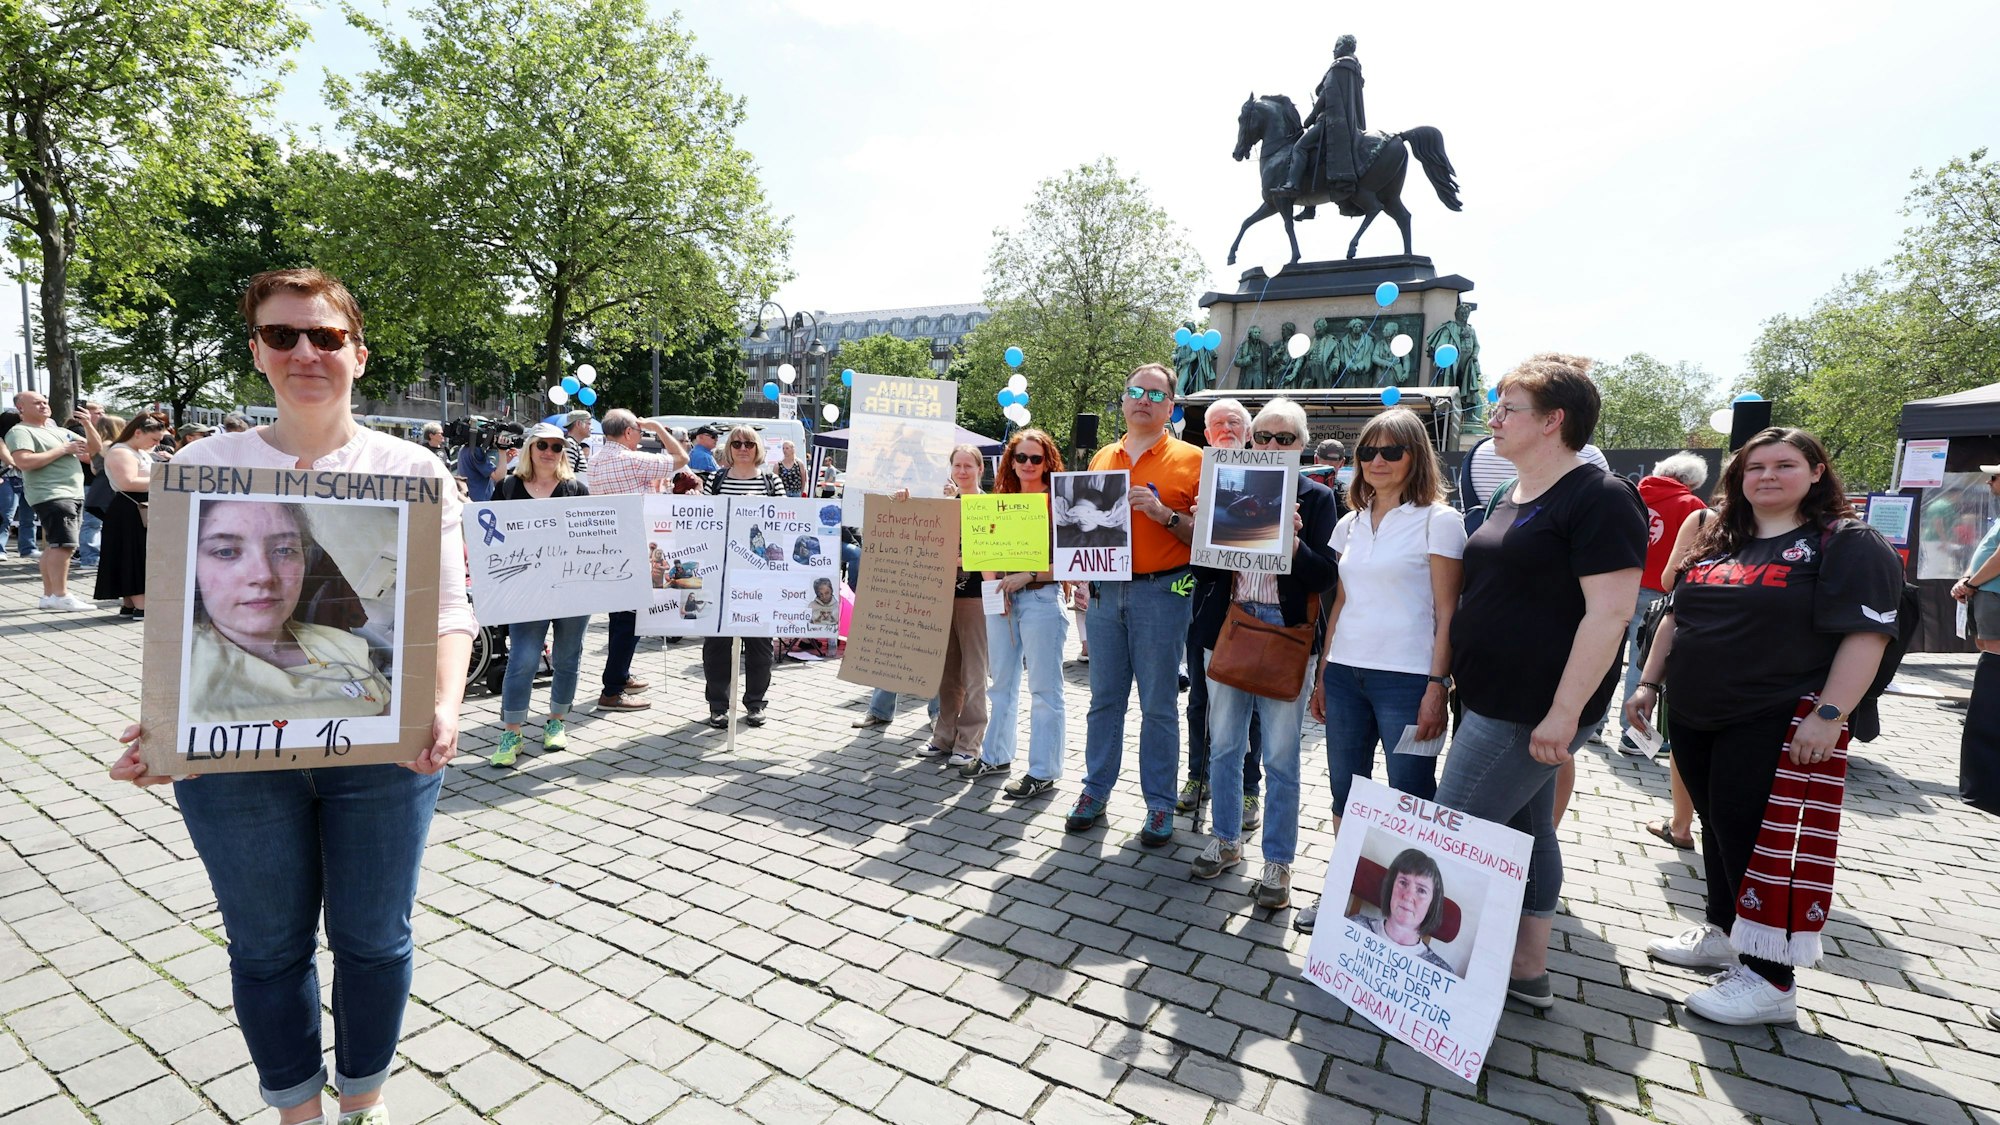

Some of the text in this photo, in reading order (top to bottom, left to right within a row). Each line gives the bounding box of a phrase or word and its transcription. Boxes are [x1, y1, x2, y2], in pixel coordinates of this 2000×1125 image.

[1309, 430, 1361, 441] gendDem
[1211, 449, 1286, 465] 18 MONATE
[163, 464, 441, 505] LEBEN IM SCHATTEN
[565, 509, 616, 518] Schmerzen
[672, 504, 714, 518] Leonie
[777, 510, 796, 520] mit
[654, 521, 672, 530] vor
[876, 512, 942, 529] schwerkrank
[568, 529, 617, 538] Dunkelheit
[870, 525, 945, 547] durch die Impfung
[547, 546, 568, 557] Wir
[577, 543, 623, 556] brauchen
[662, 542, 708, 560] Handball
[727, 539, 766, 570] Rollstuhl
[903, 545, 914, 556] 17
[916, 547, 939, 559] Jahre
[768, 561, 789, 572] Bett
[809, 557, 832, 567] Sofa
[912, 560, 945, 572] Schmerzen
[1068, 548, 1130, 572] ANNE 17
[1194, 549, 1211, 563] DER
[1252, 553, 1287, 572] ALLTAG
[562, 558, 632, 580] Hilfe!
[693, 563, 719, 578] Kanu
[1686, 563, 1792, 588] REWE
[731, 589, 763, 600] Schule
[781, 589, 807, 601] Sport
[648, 600, 680, 615] Musik
[875, 600, 932, 617] seit 2 Jahren
[732, 612, 760, 623] Musik
[773, 610, 811, 621] Freunde
[776, 624, 806, 634] treffen
[908, 675, 927, 687] Hilfe
[186, 719, 352, 762] LOTTI, 16
[1397, 795, 1464, 832] SILKE
[1350, 802, 1524, 881] SEIT 2021 HAUSGEBUNDEN
[1344, 925, 1457, 994] ZU 90% ISOLIERT
[1356, 948, 1431, 1000] HINTER DER
[1338, 953, 1451, 1031] SCHALLSCHUTZTÜR
[1309, 956, 1482, 1079] WAS IST DARAN LEBEN?
